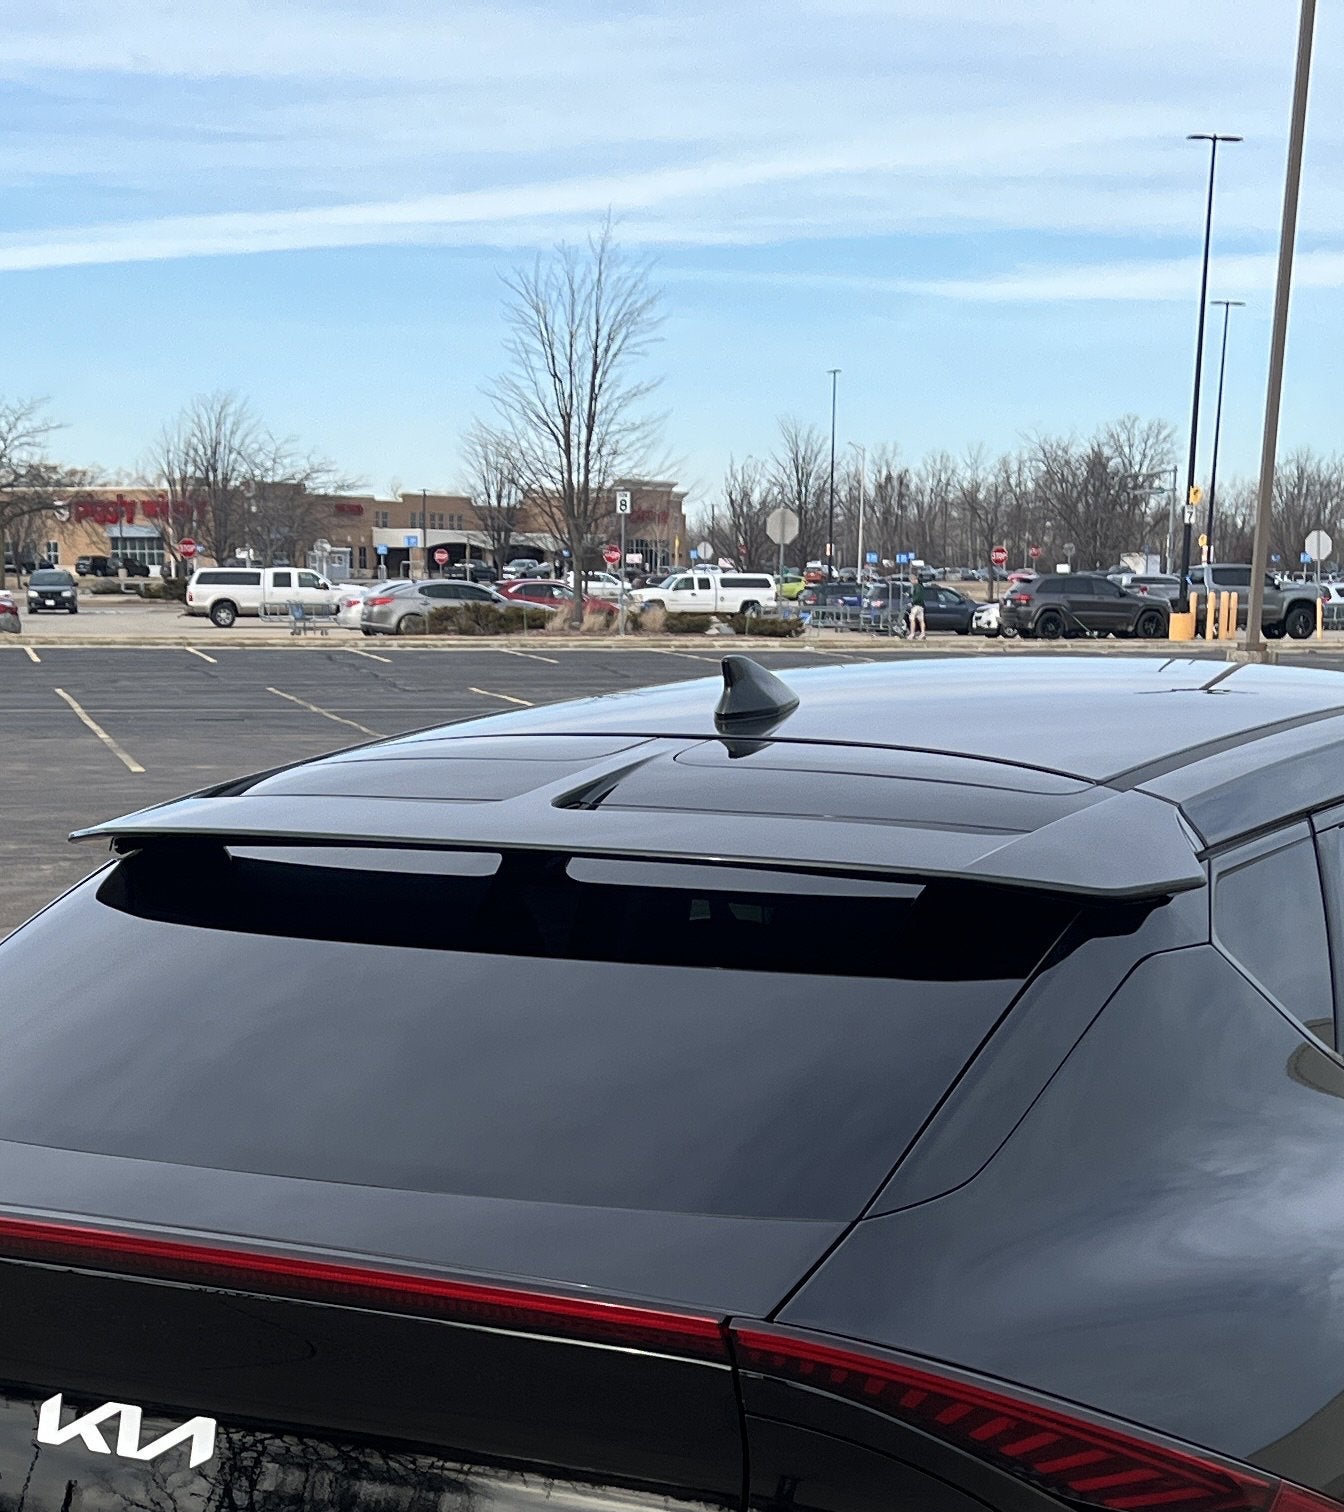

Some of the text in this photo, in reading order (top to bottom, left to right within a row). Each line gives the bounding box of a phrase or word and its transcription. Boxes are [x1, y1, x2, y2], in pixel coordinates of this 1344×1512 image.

[619, 499, 628, 512] 8
[1187, 511, 1194, 522] 7
[36, 1392, 218, 1469] KIA
